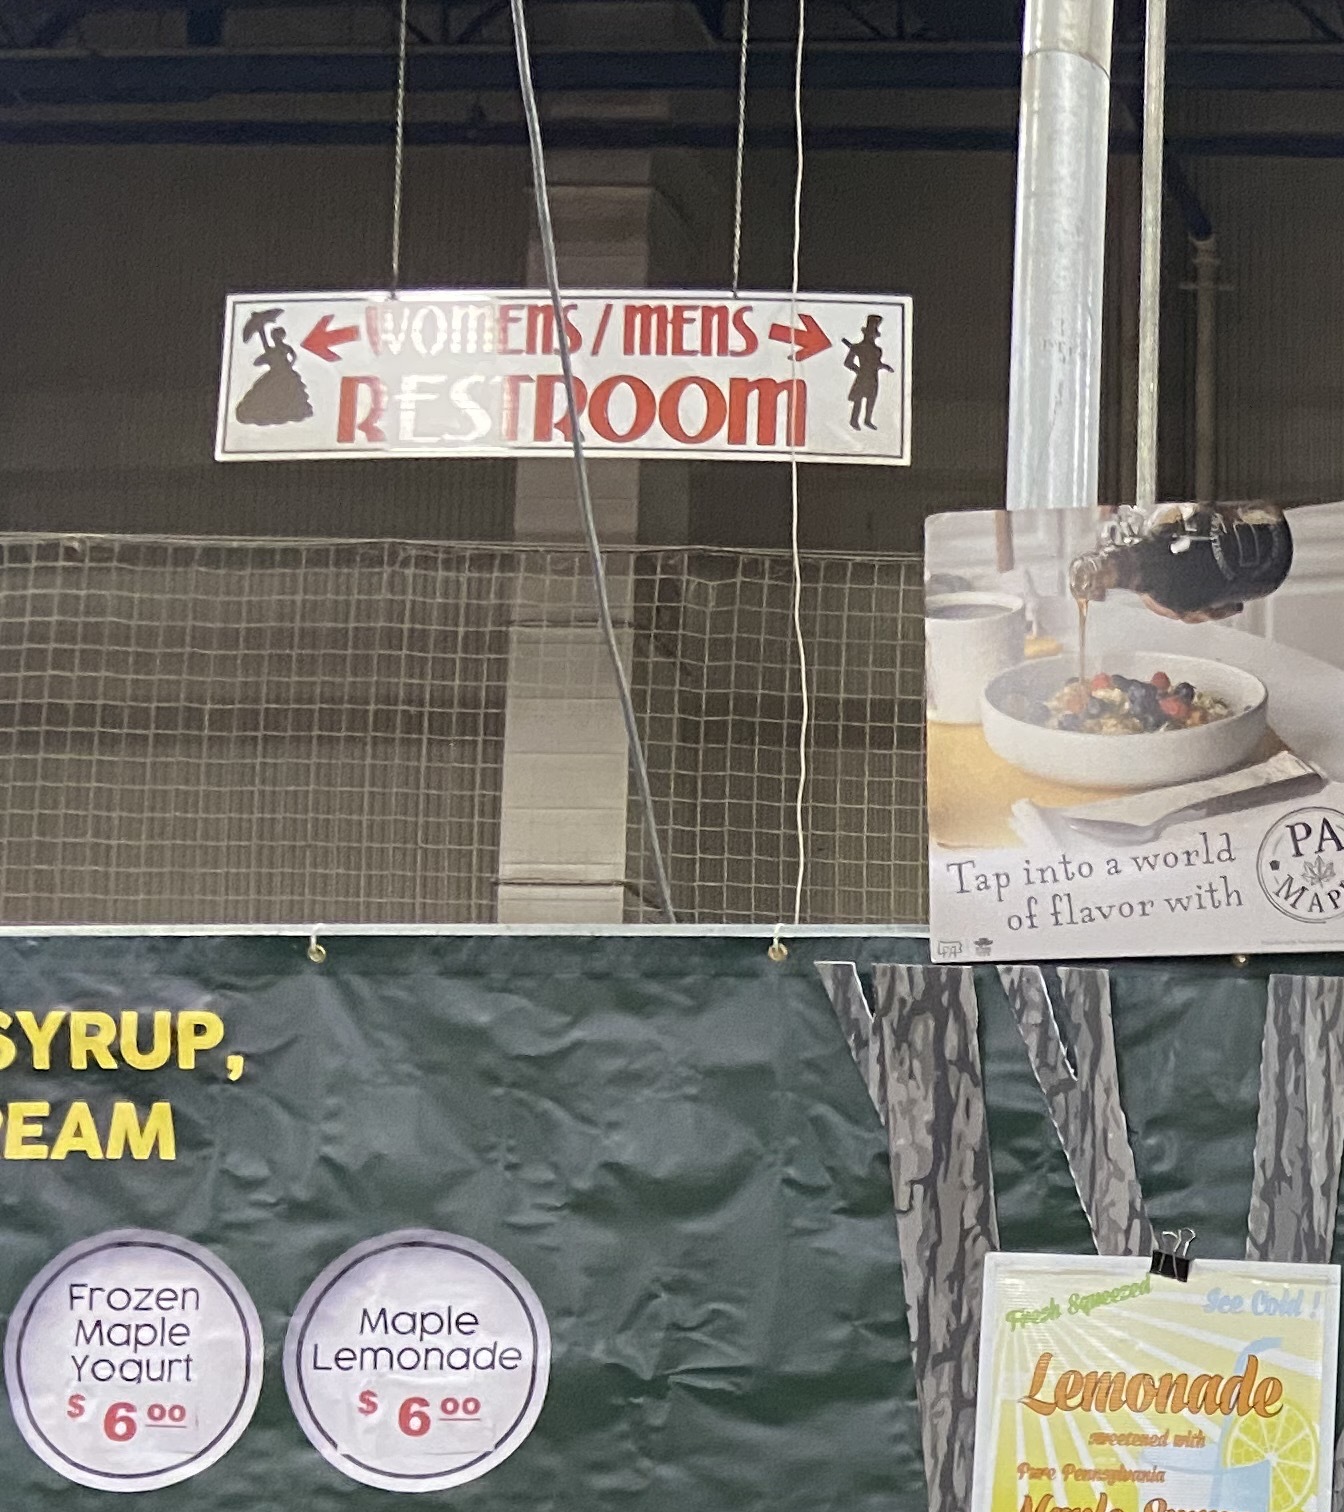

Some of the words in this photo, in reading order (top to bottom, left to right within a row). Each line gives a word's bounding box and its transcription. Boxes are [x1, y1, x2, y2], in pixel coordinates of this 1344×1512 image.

[337, 374, 806, 446] RESTROOM
[947, 860, 1011, 901] Tap
[1024, 854, 1093, 888] into
[1106, 855, 1122, 876] a
[1131, 832, 1236, 870] world
[1007, 898, 1039, 931] of
[1050, 892, 1155, 929] flavor
[1166, 876, 1244, 912] with
[0, 1102, 176, 1160] EAM
[69, 1283, 200, 1311] Frozen
[75, 1318, 190, 1353] Maple
[359, 1306, 479, 1341] Maple
[71, 1353, 193, 1385] Yogurt
[312, 1341, 522, 1372] Lemonade
[1018, 1352, 1284, 1418] Lemonade
[1174, 1428, 1206, 1449] with
[1017, 1462, 1055, 1482] Pure
[1062, 1463, 1165, 1487] Pennsylvania
